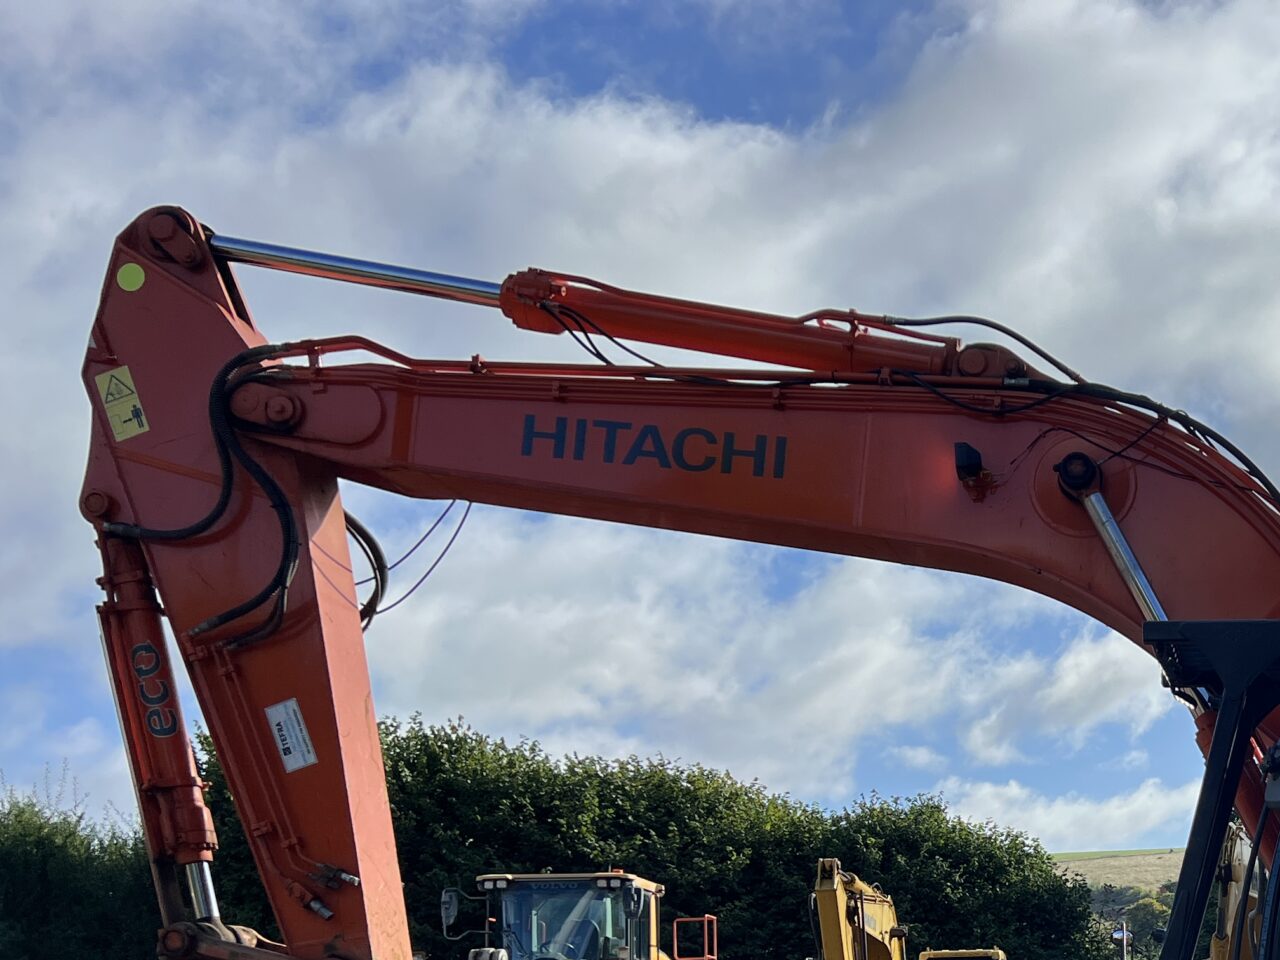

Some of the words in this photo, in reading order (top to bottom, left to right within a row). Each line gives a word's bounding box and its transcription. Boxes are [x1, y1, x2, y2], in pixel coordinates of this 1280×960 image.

[521, 414, 787, 479] HITACHI
[132, 642, 178, 737] eco
[275, 721, 289, 748] TEFRA
